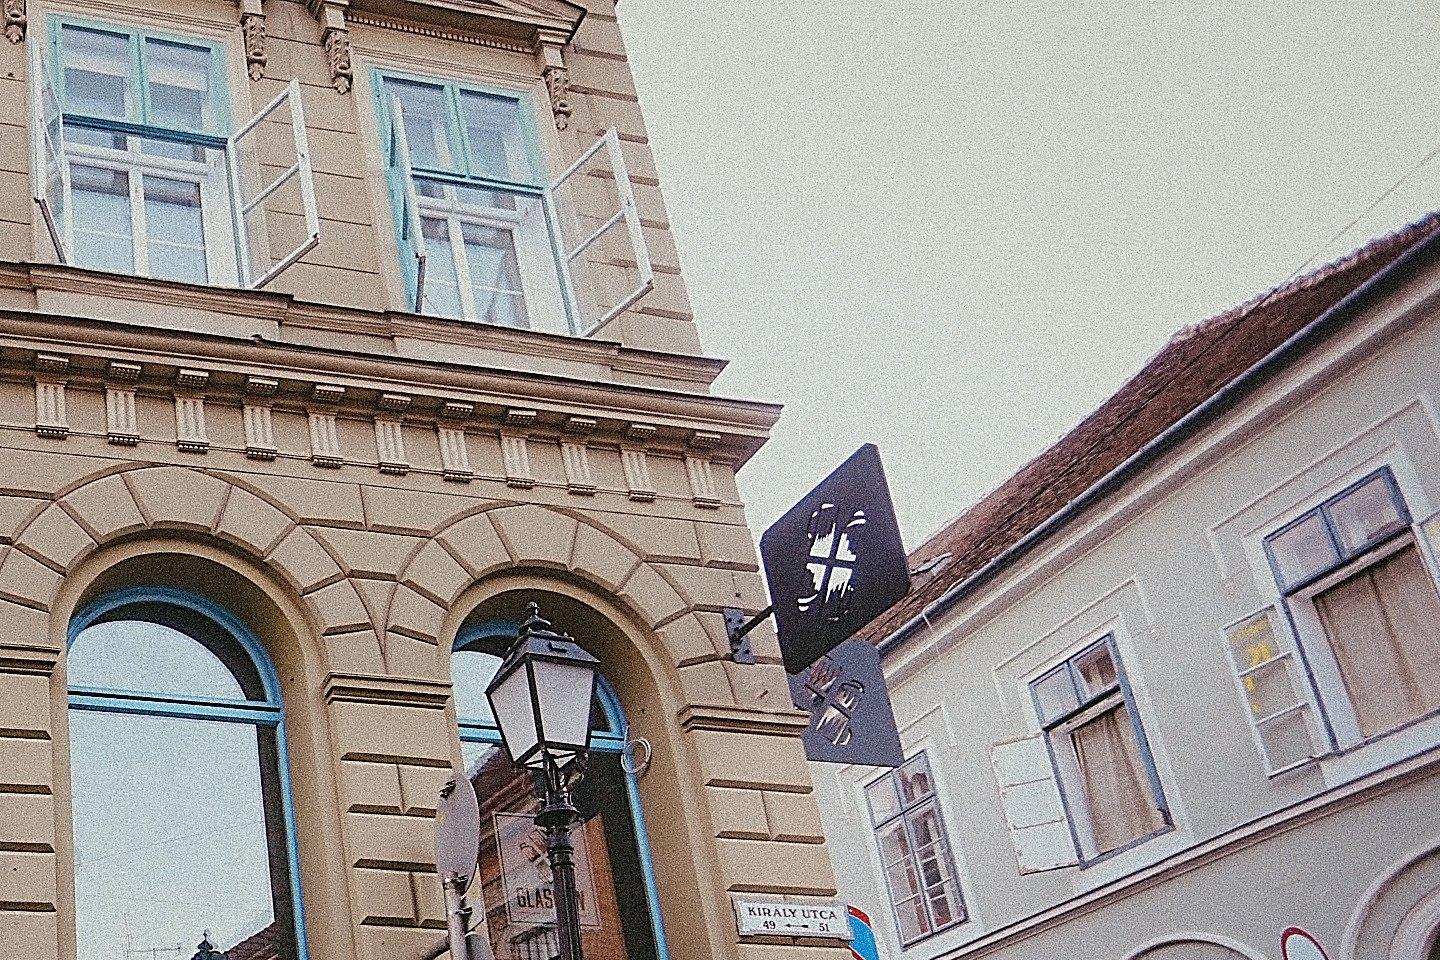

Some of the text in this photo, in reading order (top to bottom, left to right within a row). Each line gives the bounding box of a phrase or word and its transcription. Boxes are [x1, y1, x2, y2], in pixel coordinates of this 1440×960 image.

[802, 909, 837, 920] UTCA
[763, 920, 829, 932] 49 51
